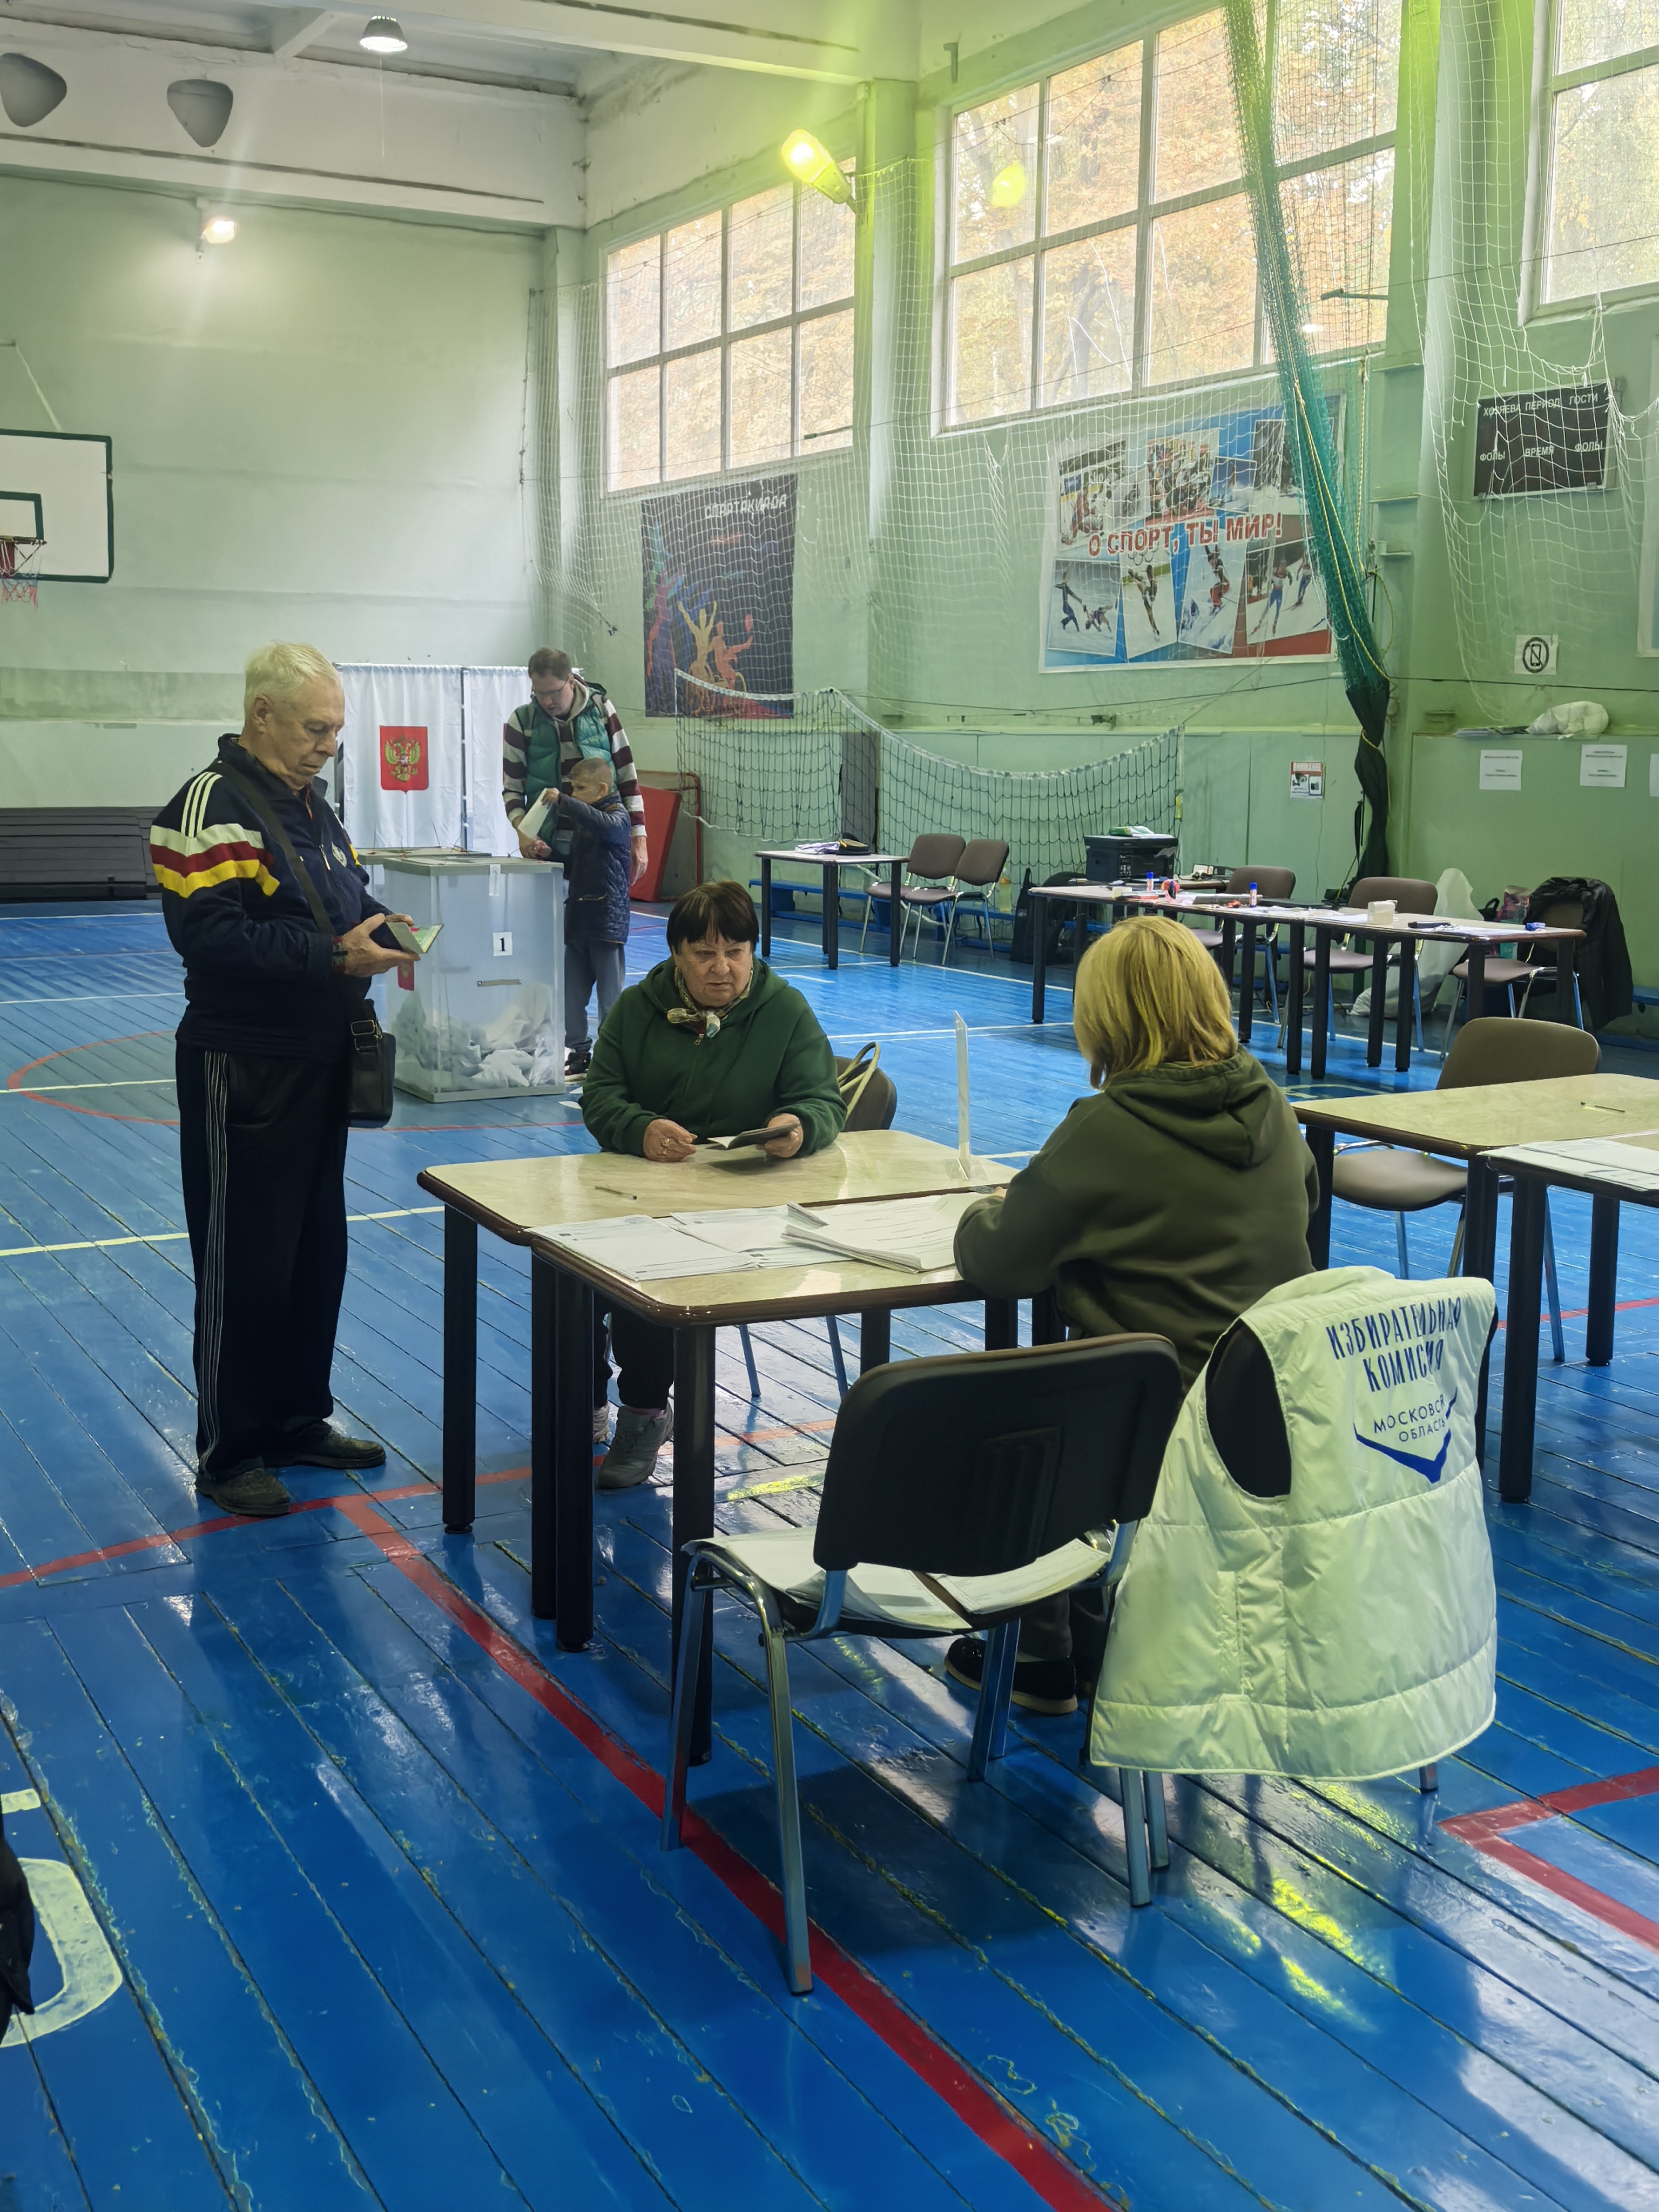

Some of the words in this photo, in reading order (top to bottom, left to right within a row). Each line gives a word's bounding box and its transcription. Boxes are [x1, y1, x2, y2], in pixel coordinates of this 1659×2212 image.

[1525, 397, 1560, 410] ПЕРИОД
[1569, 394, 1598, 405] ГОСТИ
[1480, 450, 1506, 461] ФОЛЫ
[1525, 446, 1554, 457] ВРЕМЯ
[1575, 441, 1603, 452] ФОЛЫ
[1088, 533, 1102, 557] О
[1107, 524, 1180, 556] СПОРТ,
[1185, 521, 1219, 547] ТЫ
[1226, 512, 1283, 542] МИР!
[500, 938, 507, 952] 1
